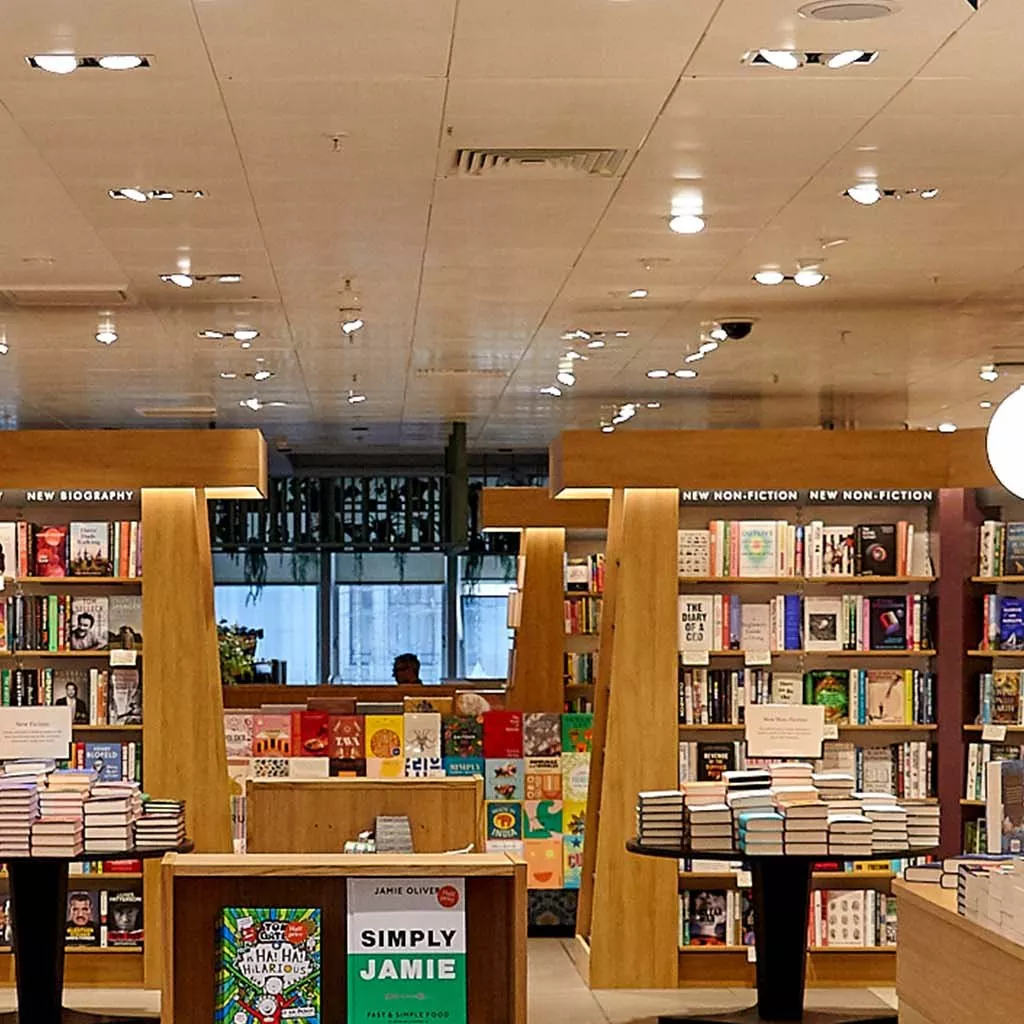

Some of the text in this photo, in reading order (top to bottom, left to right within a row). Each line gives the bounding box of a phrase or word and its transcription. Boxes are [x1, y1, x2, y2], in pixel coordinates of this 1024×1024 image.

[27, 490, 133, 501] NEW BIOGRAPHY
[682, 490, 798, 501] NEW NON-FICTION
[809, 490, 933, 501] NEW NON-FICTION
[686, 603, 703, 612] THE
[681, 613, 707, 622] DIARY
[685, 623, 697, 631] OF
[686, 632, 704, 642] CEO
[491, 829, 518, 838] INDIA
[374, 886, 403, 895] JAMIE
[360, 929, 457, 948] SIMPLY
[256, 948, 277, 963] HA!
[281, 948, 304, 963] HA!
[359, 958, 457, 981] JAMIE
[367, 1011, 386, 1019] FAST
[395, 1011, 423, 1019] SIMPLE
[425, 1011, 450, 1019] FOOD
